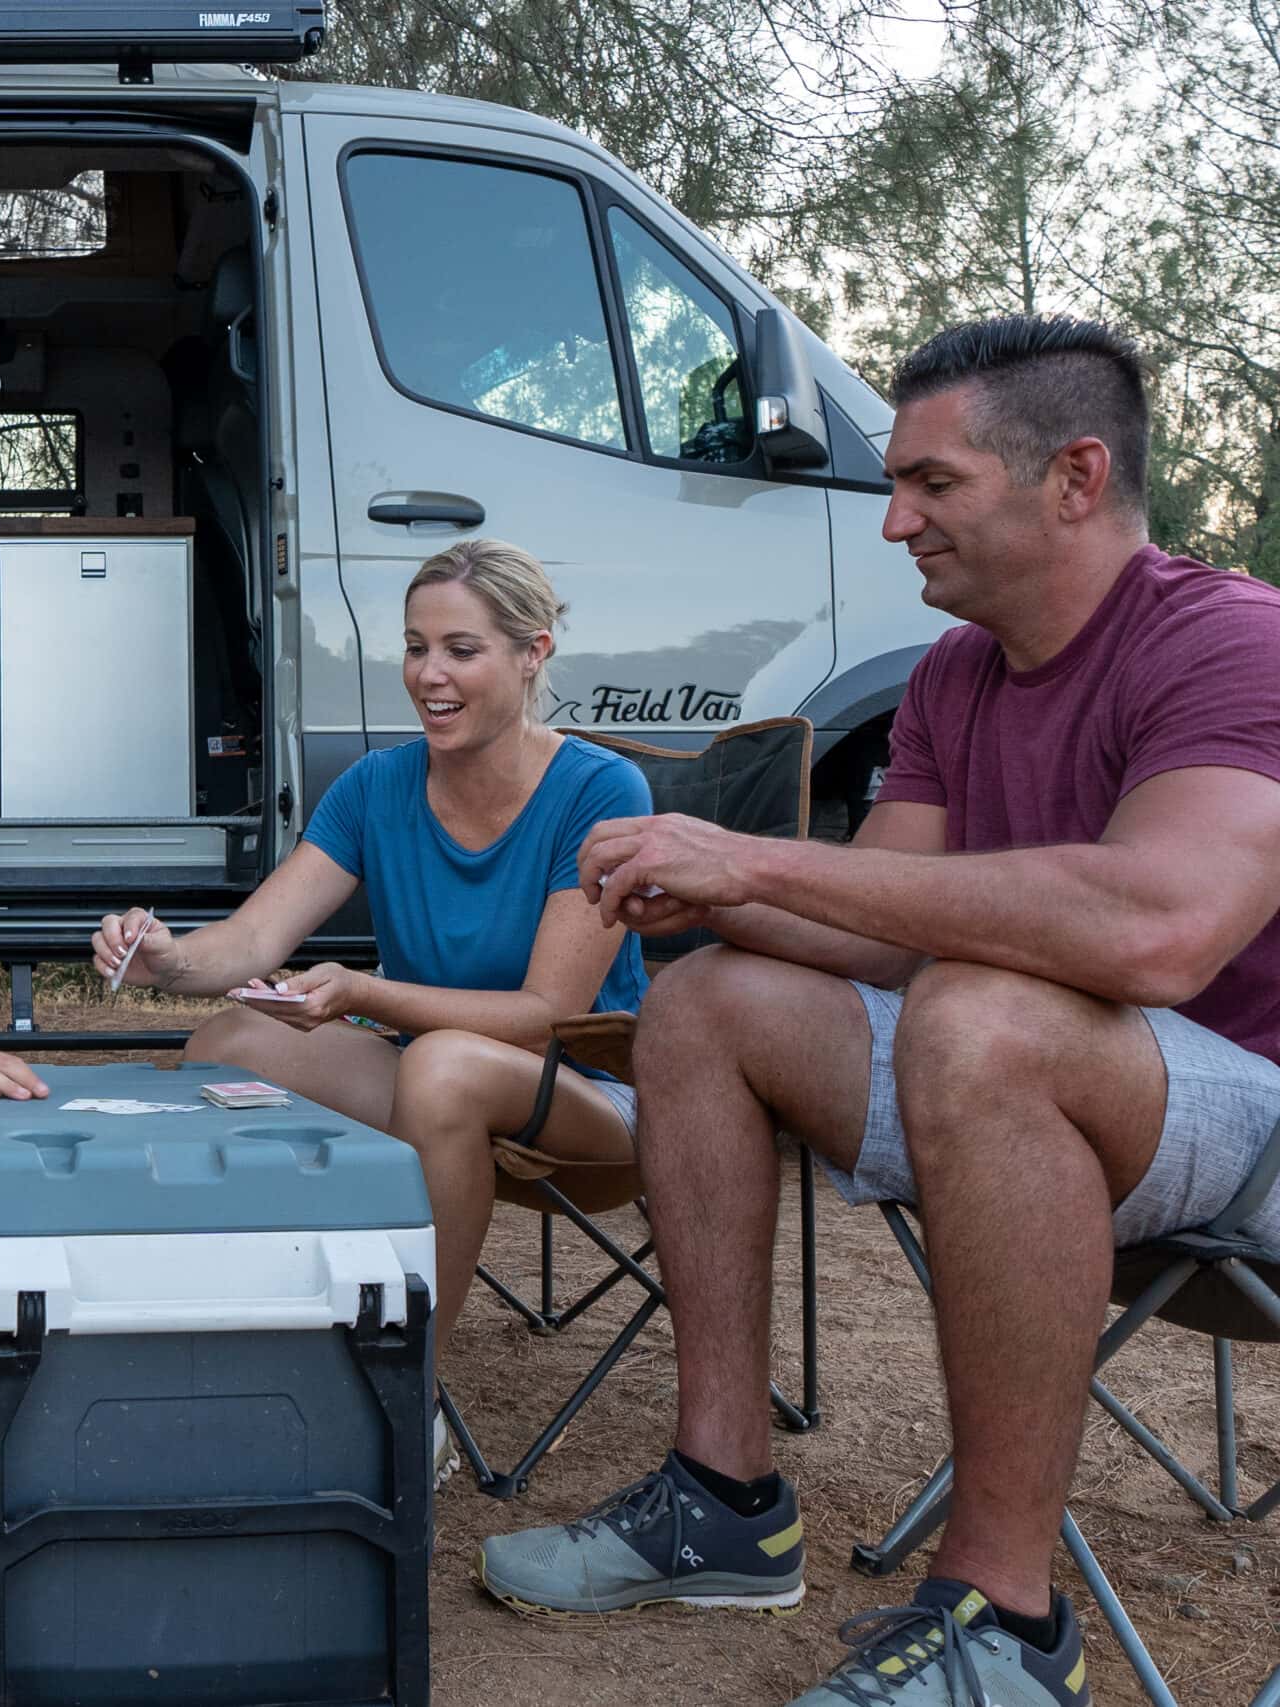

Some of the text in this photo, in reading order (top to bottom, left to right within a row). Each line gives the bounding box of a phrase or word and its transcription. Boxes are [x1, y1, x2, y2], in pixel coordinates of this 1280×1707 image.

[199, 13, 236, 27] FIAMMA
[591, 684, 742, 723] Field Van
